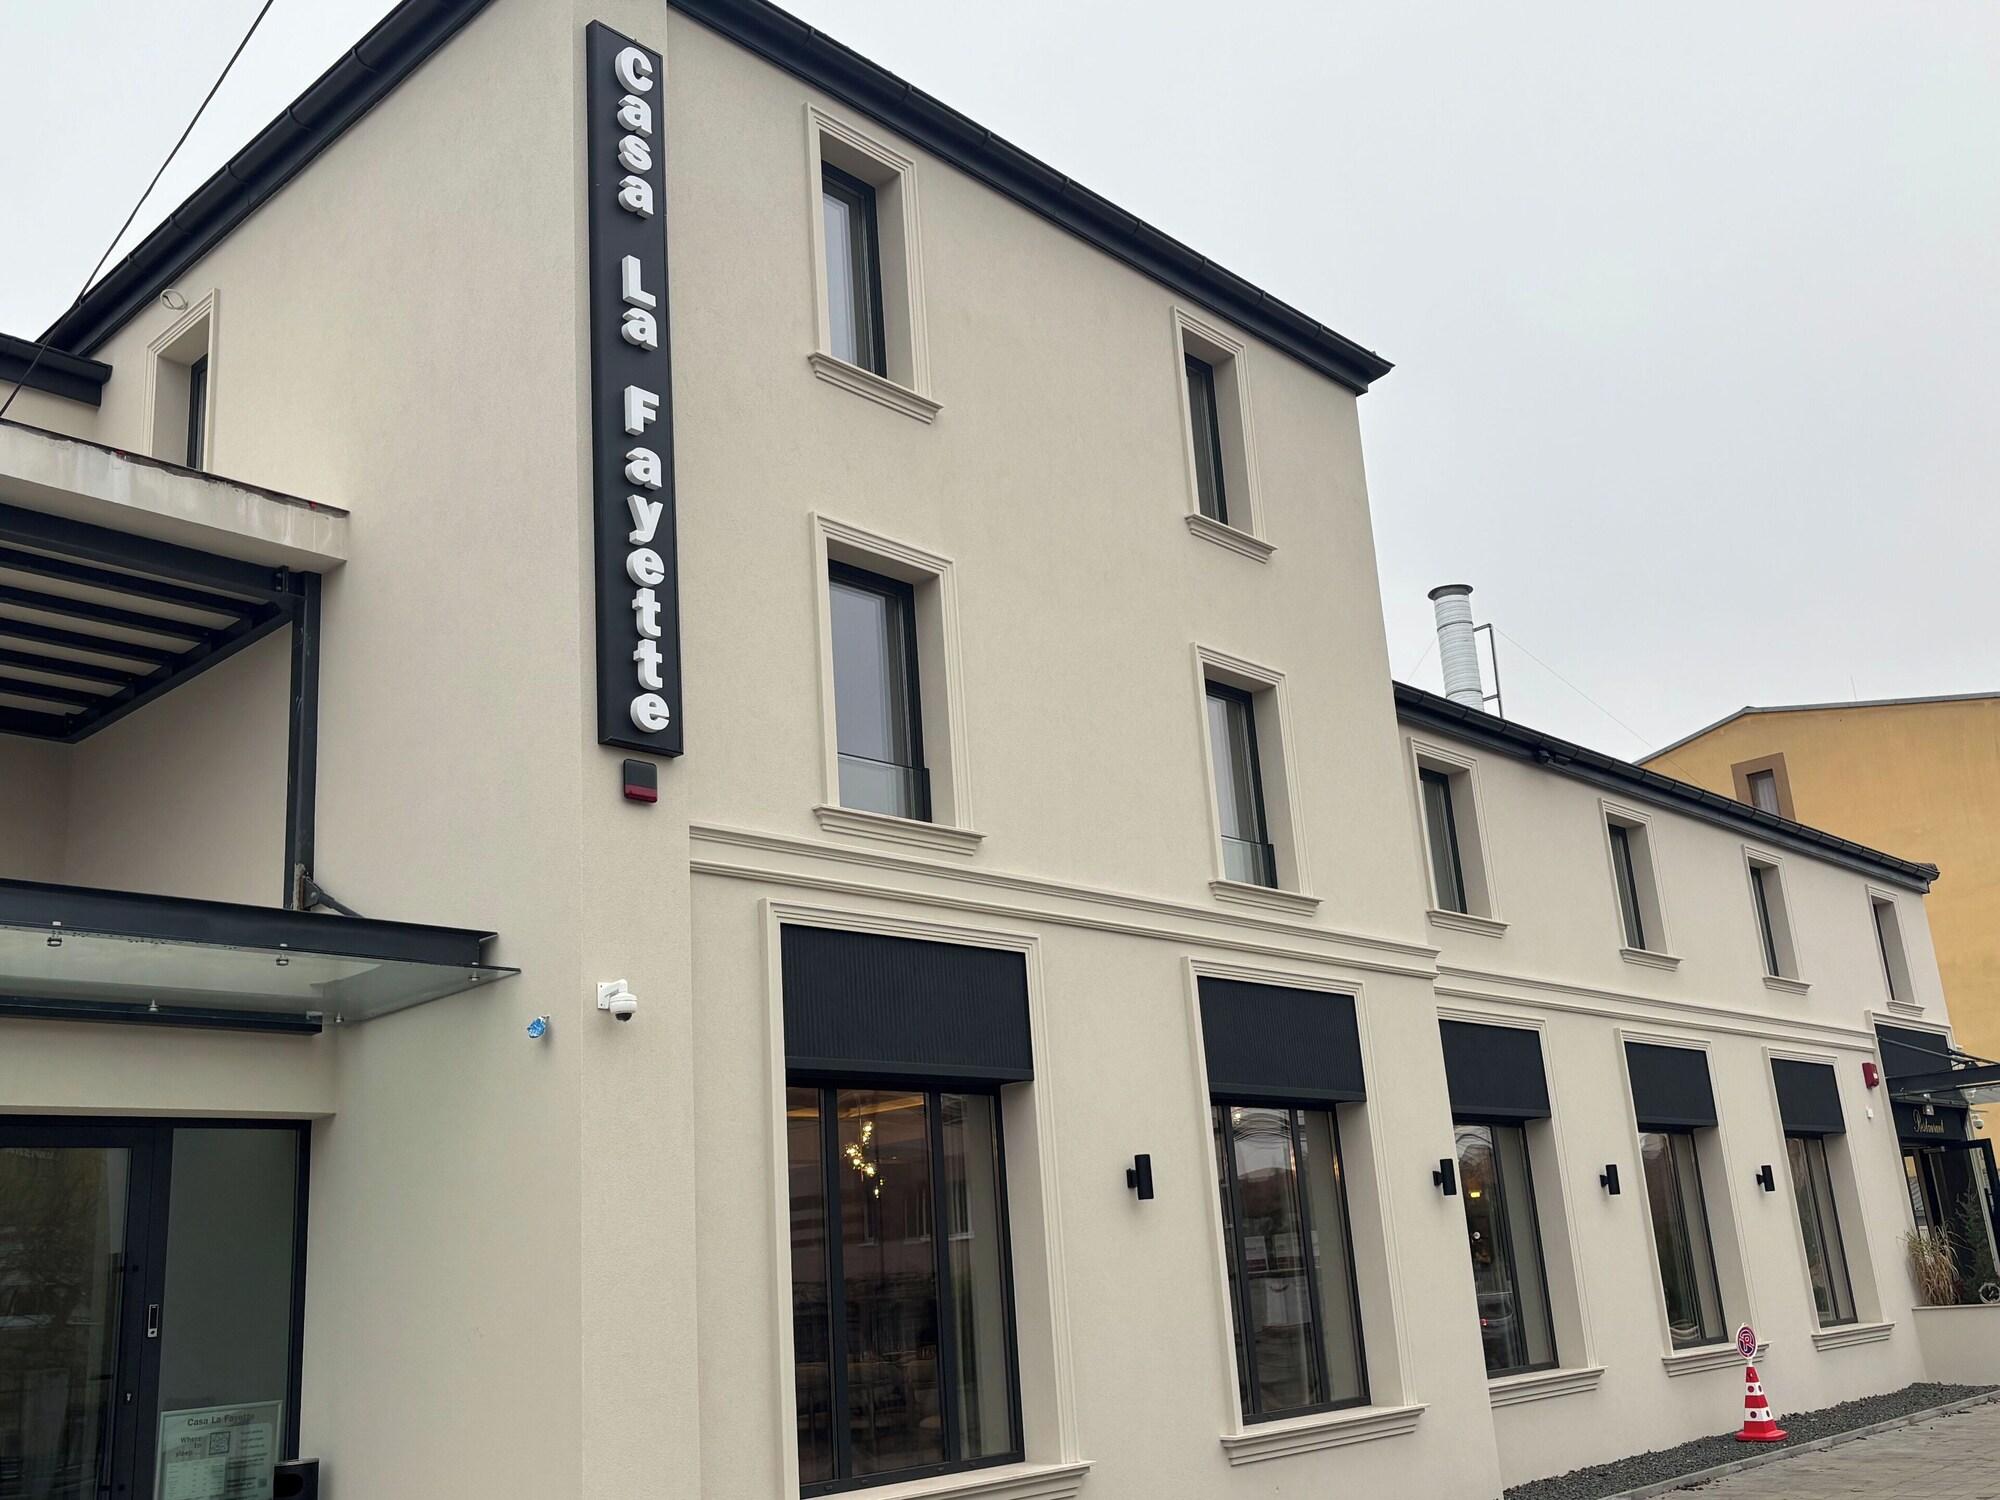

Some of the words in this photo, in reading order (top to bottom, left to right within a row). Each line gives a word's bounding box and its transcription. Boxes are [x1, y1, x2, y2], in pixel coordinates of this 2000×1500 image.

[614, 46, 655, 220] Casa
[621, 254, 658, 352] La
[624, 384, 670, 733] Fayette
[187, 1417, 208, 1426] Casa
[211, 1415, 222, 1424] La
